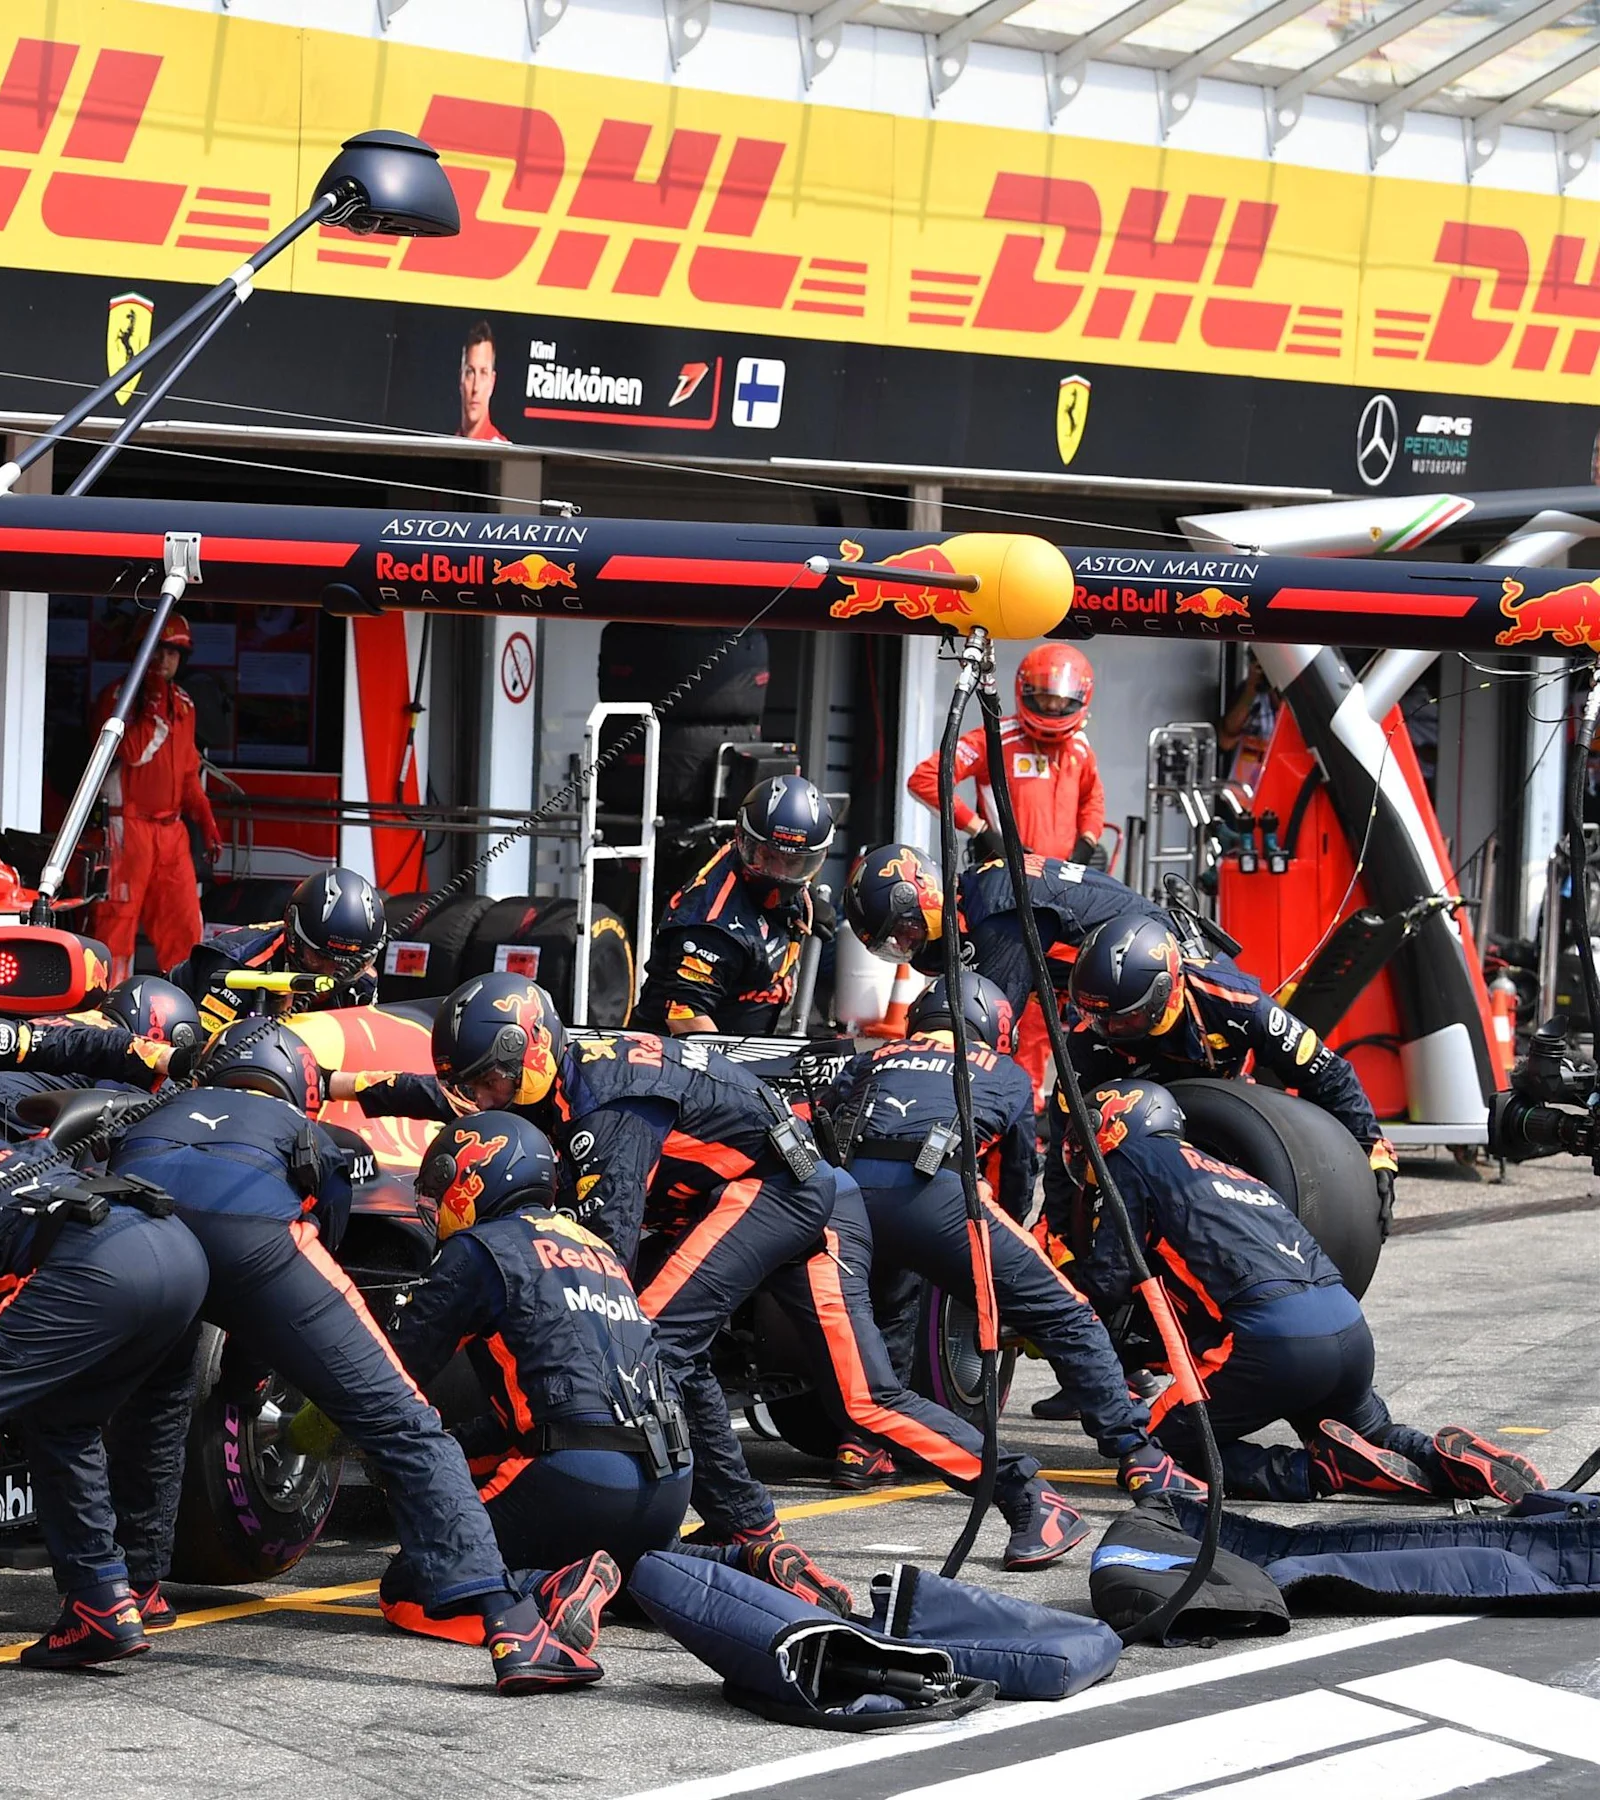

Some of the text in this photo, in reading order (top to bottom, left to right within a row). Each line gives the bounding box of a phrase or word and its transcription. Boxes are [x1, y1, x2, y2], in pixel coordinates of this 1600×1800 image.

[400, 96, 801, 309] DHL
[974, 172, 1292, 352] DHL
[530, 340, 556, 360] Kimi
[526, 362, 643, 406] Räikkönen
[1404, 436, 1468, 457] PETRONAS
[1412, 459, 1467, 475] MOTORSPORT
[381, 518, 588, 544] ASTON MARTIN
[1076, 556, 1259, 579] ASTON MARTIN
[379, 587, 584, 610] RACING
[1075, 615, 1255, 636] RACING
[591, 917, 625, 939] ZERO
[696, 949, 720, 963] AT&T
[221, 988, 242, 1006] AT&T
[703, 1044, 725, 1054] TIN
[350, 1155, 374, 1185] RIX
[563, 1286, 638, 1321] Mobil
[224, 1404, 261, 1535] ZERO
